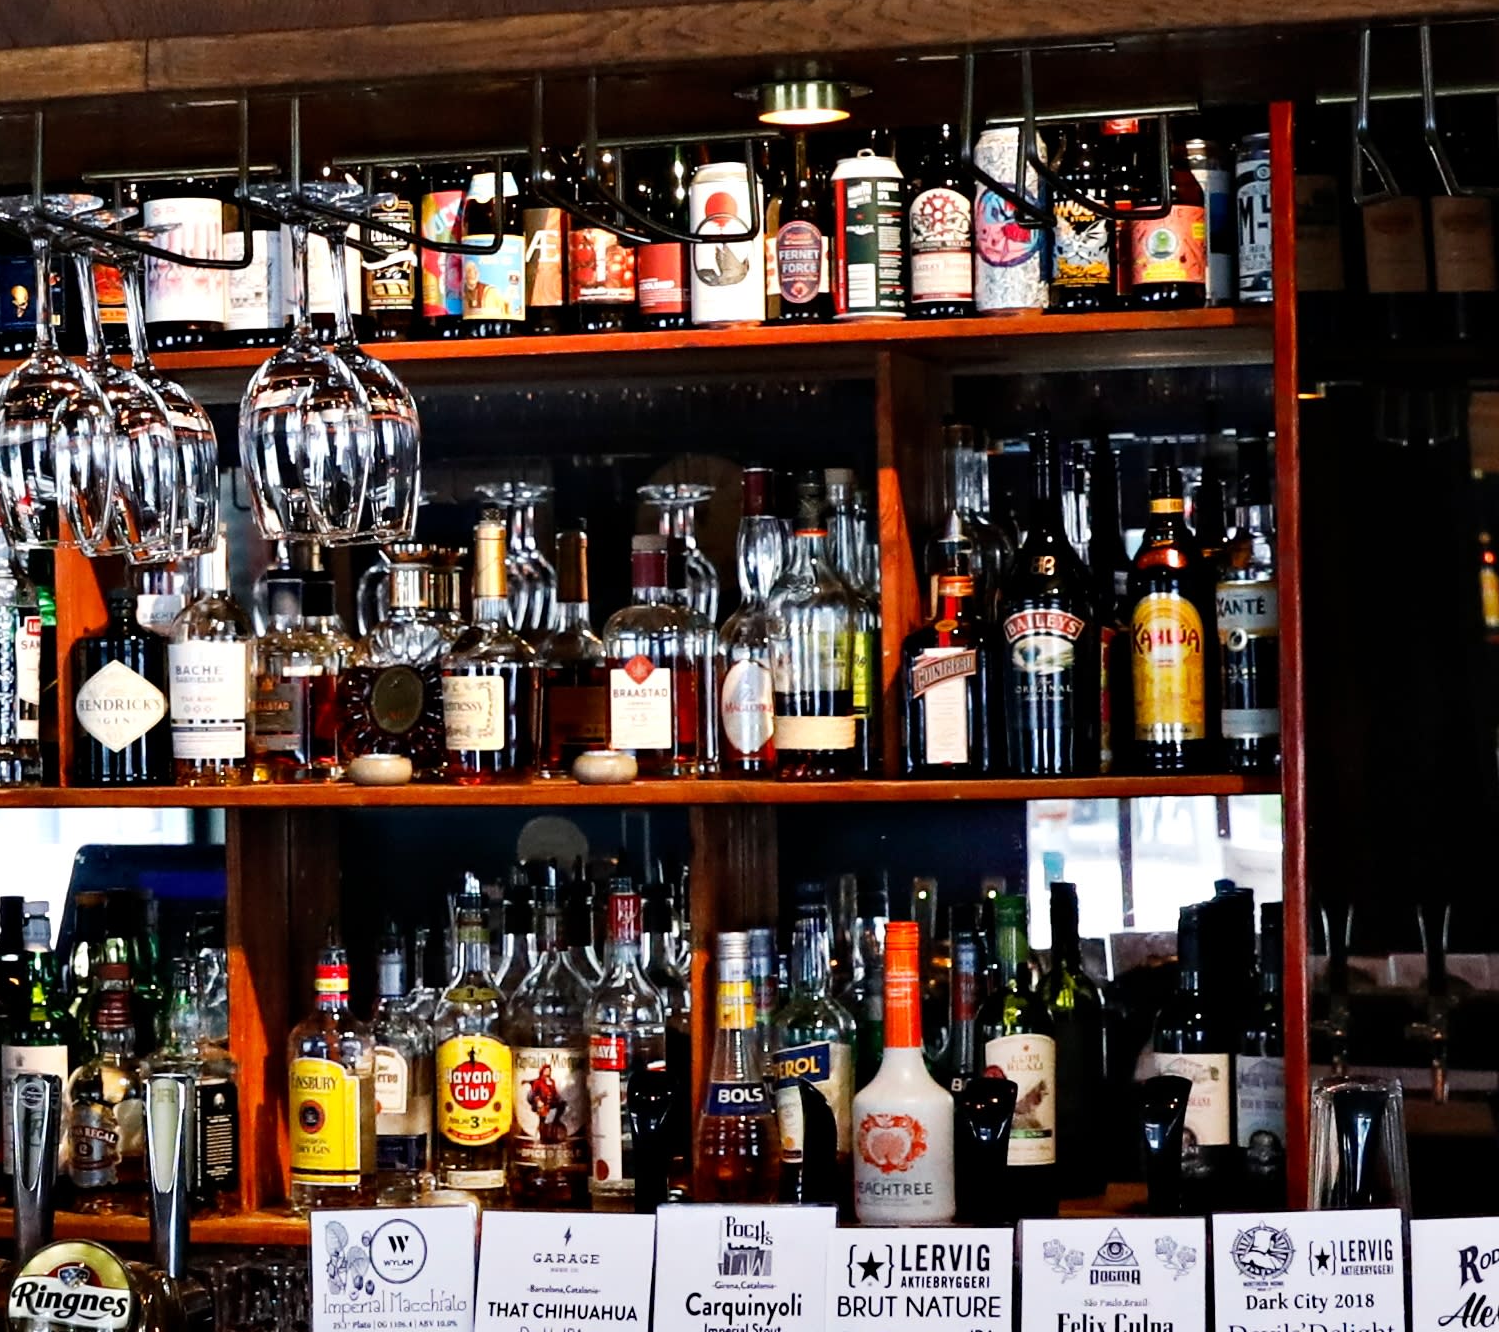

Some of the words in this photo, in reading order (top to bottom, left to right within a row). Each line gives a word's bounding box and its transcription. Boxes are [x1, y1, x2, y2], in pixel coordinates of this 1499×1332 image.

[779, 250, 819, 260] FERNET
[782, 262, 818, 273] FORCE
[1008, 613, 1076, 636] BAILEYS
[613, 688, 668, 698] BRAASTAD
[446, 1068, 501, 1084] Havana
[455, 1084, 490, 1101] Club
[718, 1087, 764, 1104] BOLS
[533, 1253, 600, 1264] GARAGE
[901, 1245, 990, 1272] LERVIG
[1340, 1239, 1393, 1262] LERVIG
[901, 1276, 990, 1288] AKTIEBRYGGERI
[1090, 1269, 1140, 1285] DOGMA
[11, 1282, 128, 1319] Ringnes
[323, 1293, 385, 1320] Imperial
[685, 1292, 802, 1326] Carquinyoli
[837, 1297, 898, 1318] BRUT
[906, 1296, 1001, 1318] NATURE
[1246, 1293, 1288, 1310] Dark
[1294, 1294, 1327, 1313] City
[1335, 1294, 1374, 1308] 2018
[488, 1302, 528, 1317] THAT
[533, 1303, 638, 1321] CHIHUAHUA
